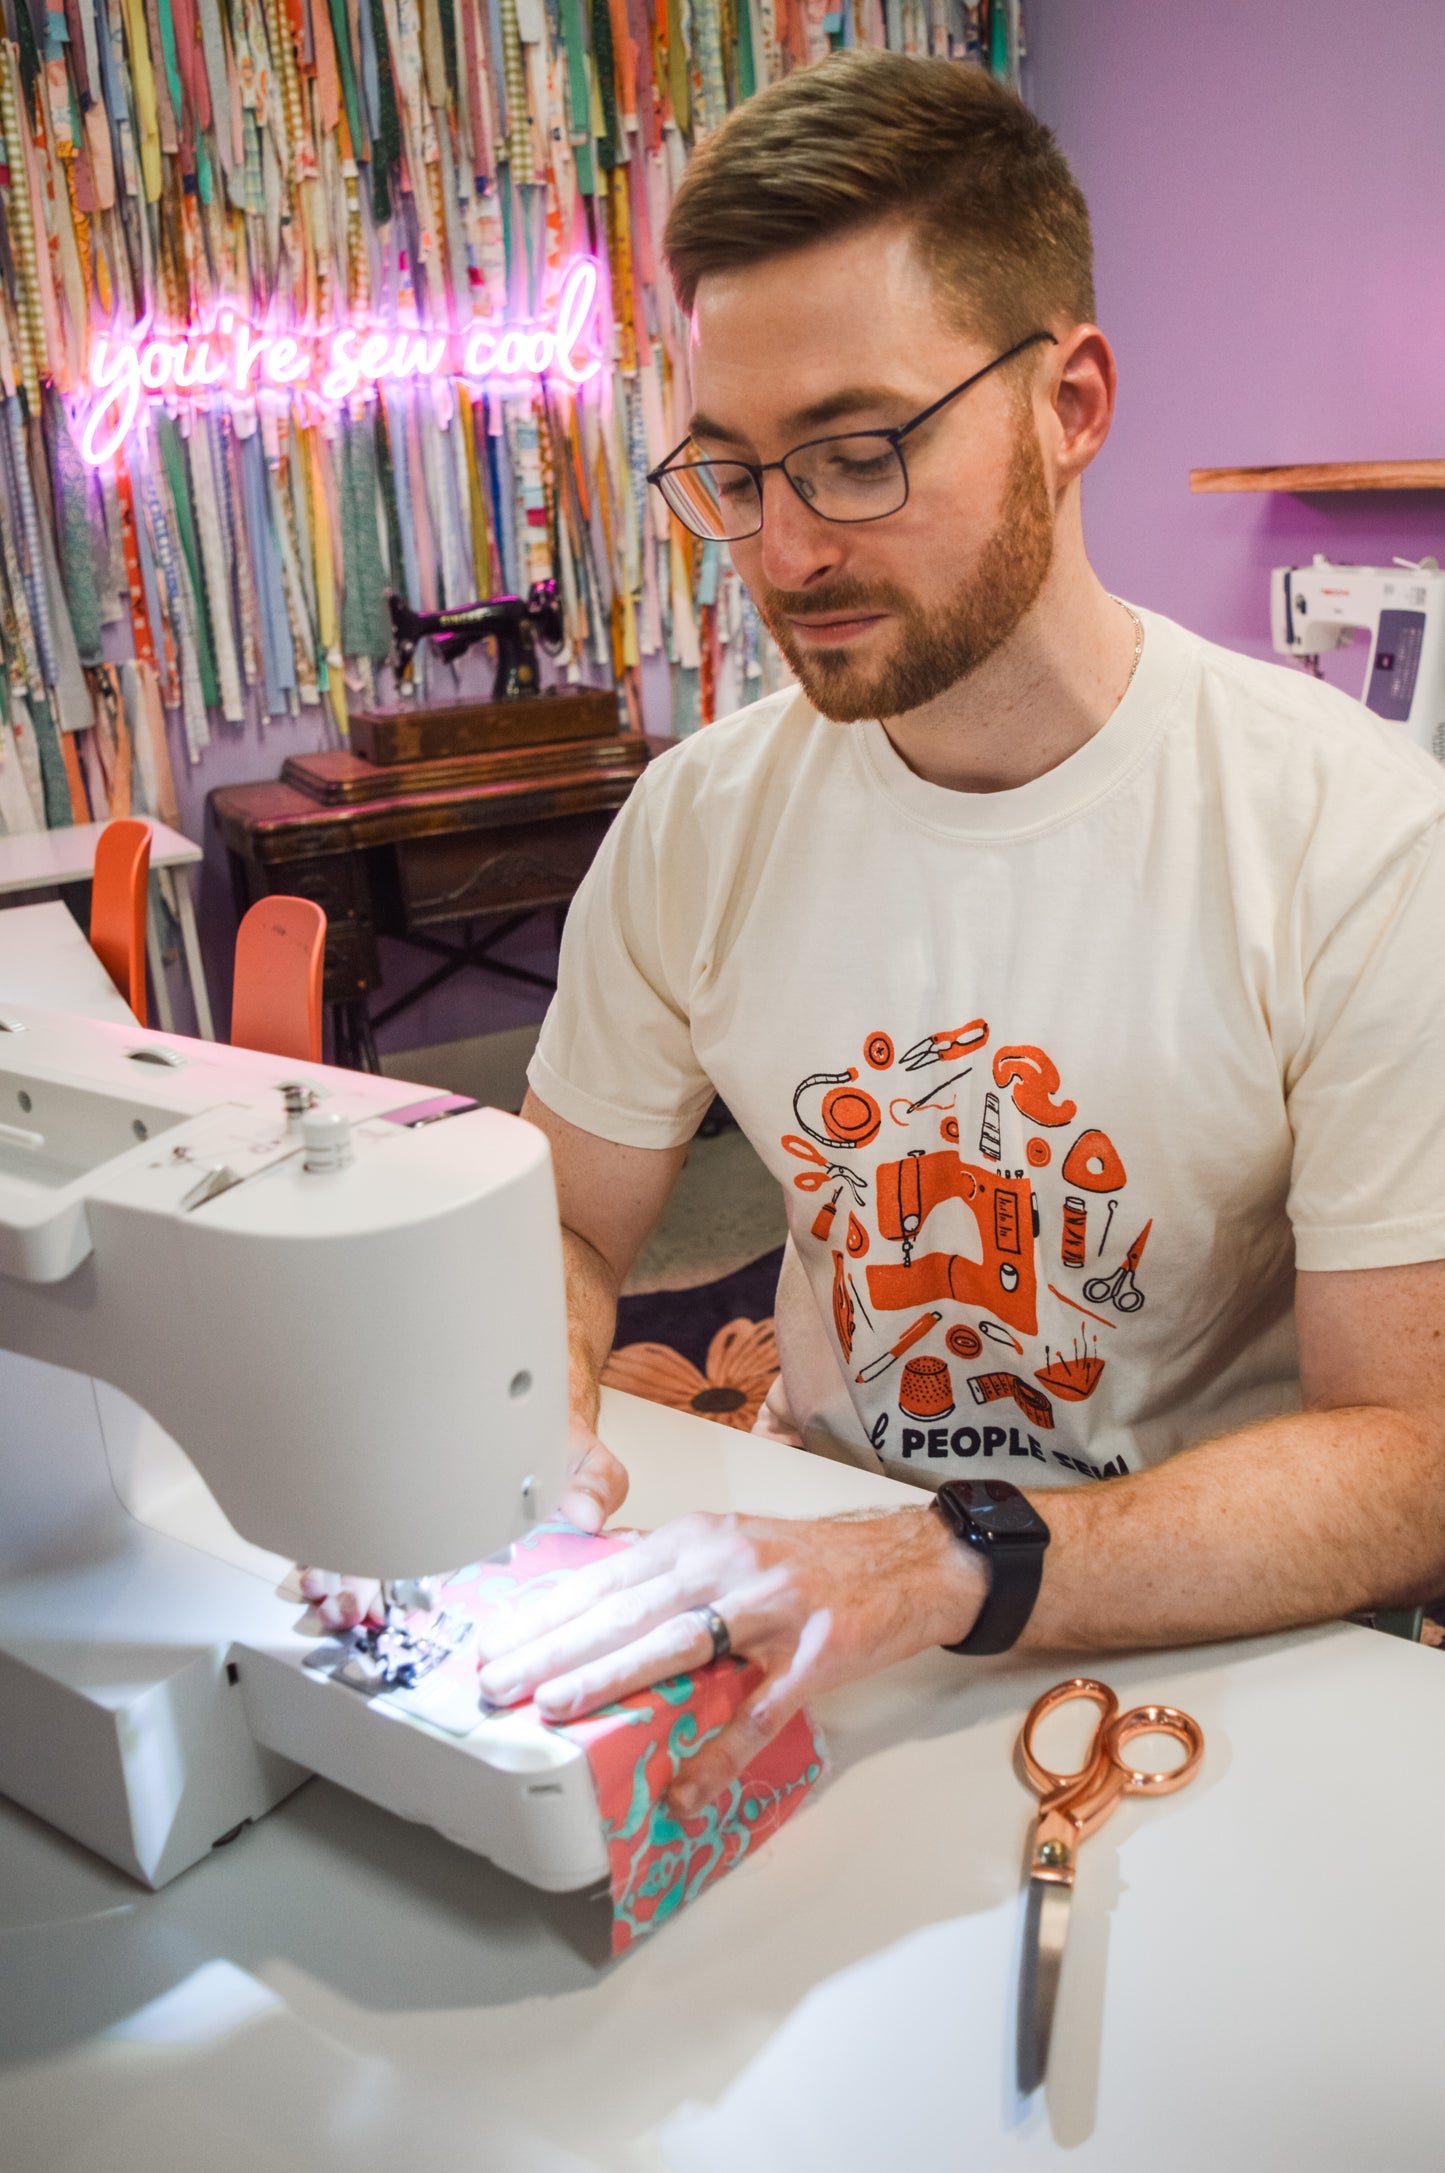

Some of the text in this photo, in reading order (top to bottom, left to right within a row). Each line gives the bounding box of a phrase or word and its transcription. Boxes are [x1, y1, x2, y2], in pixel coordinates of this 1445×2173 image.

[81, 262, 602, 466] you're sew cool
[901, 1426, 1047, 1464] PEOPLE
